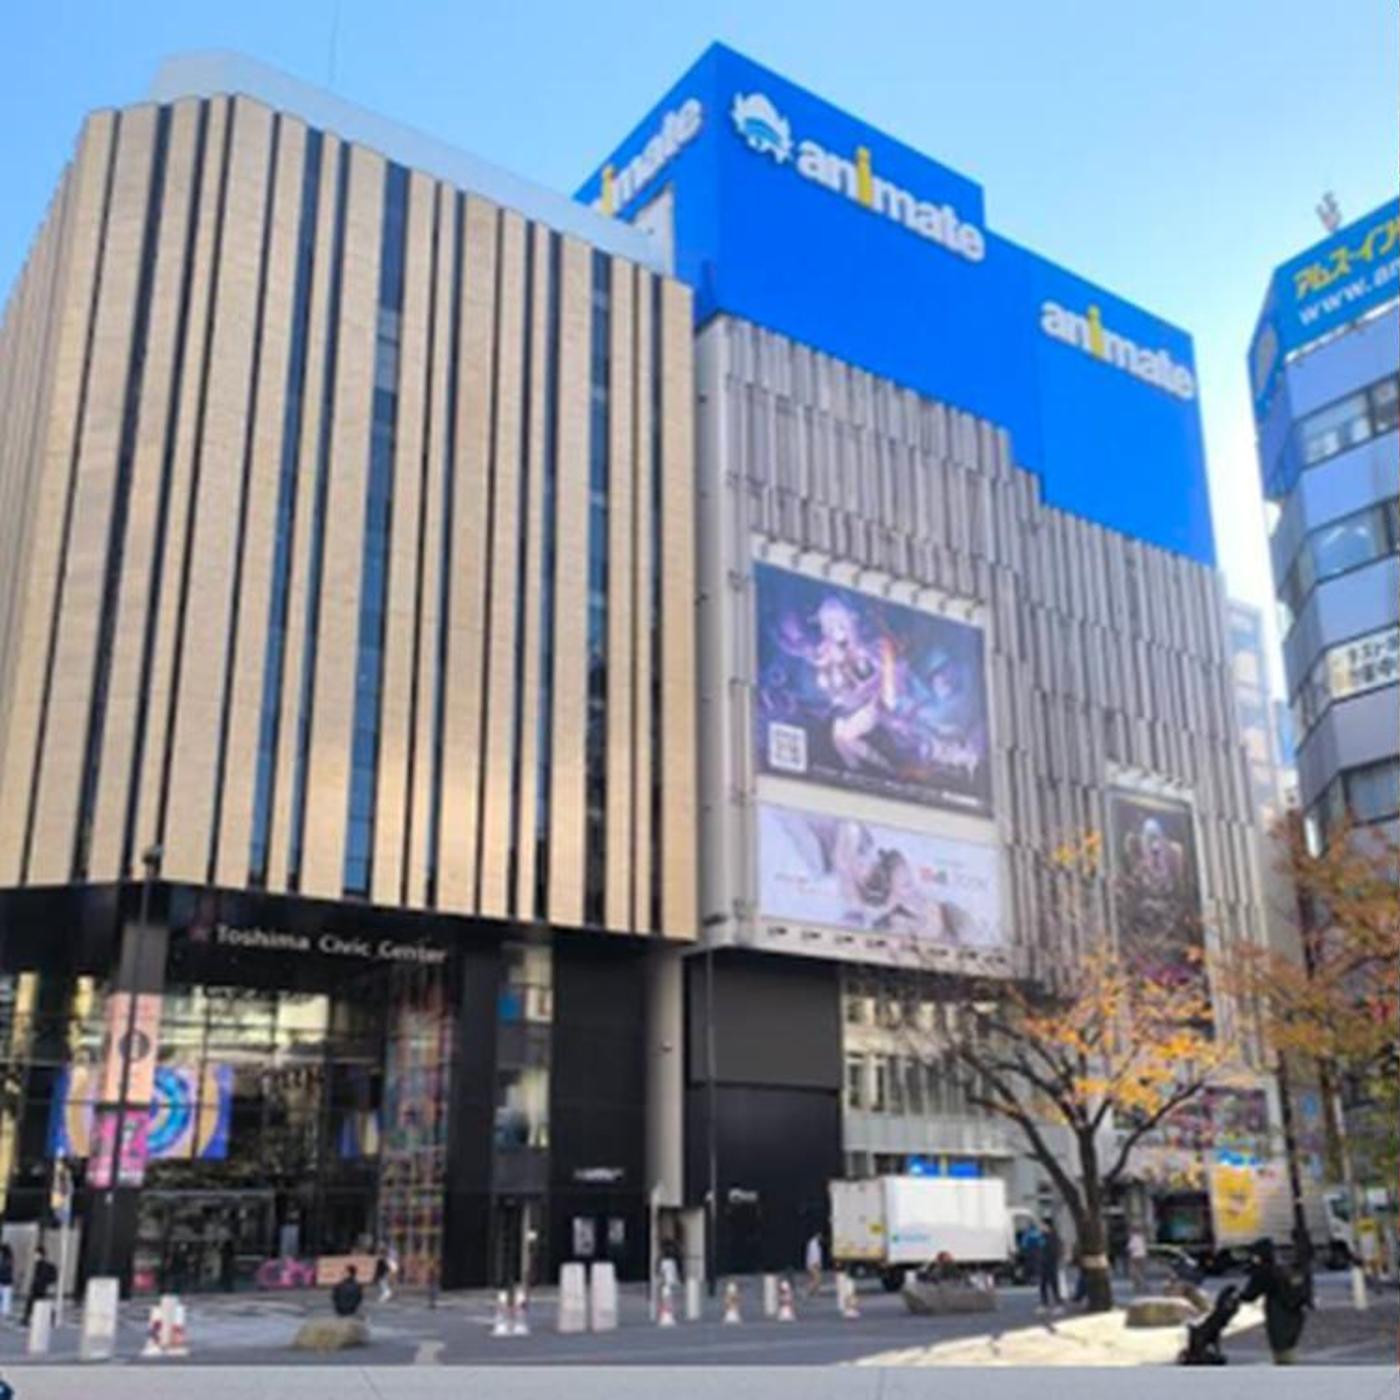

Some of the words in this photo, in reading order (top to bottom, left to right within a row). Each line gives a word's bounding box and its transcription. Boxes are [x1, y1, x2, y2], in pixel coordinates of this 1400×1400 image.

[591, 97, 702, 217] imate
[797, 139, 985, 263] animate
[1040, 300, 1195, 400] animate
[217, 924, 310, 949] Toshima
[319, 934, 371, 957] Civic
[379, 940, 447, 963] Center
